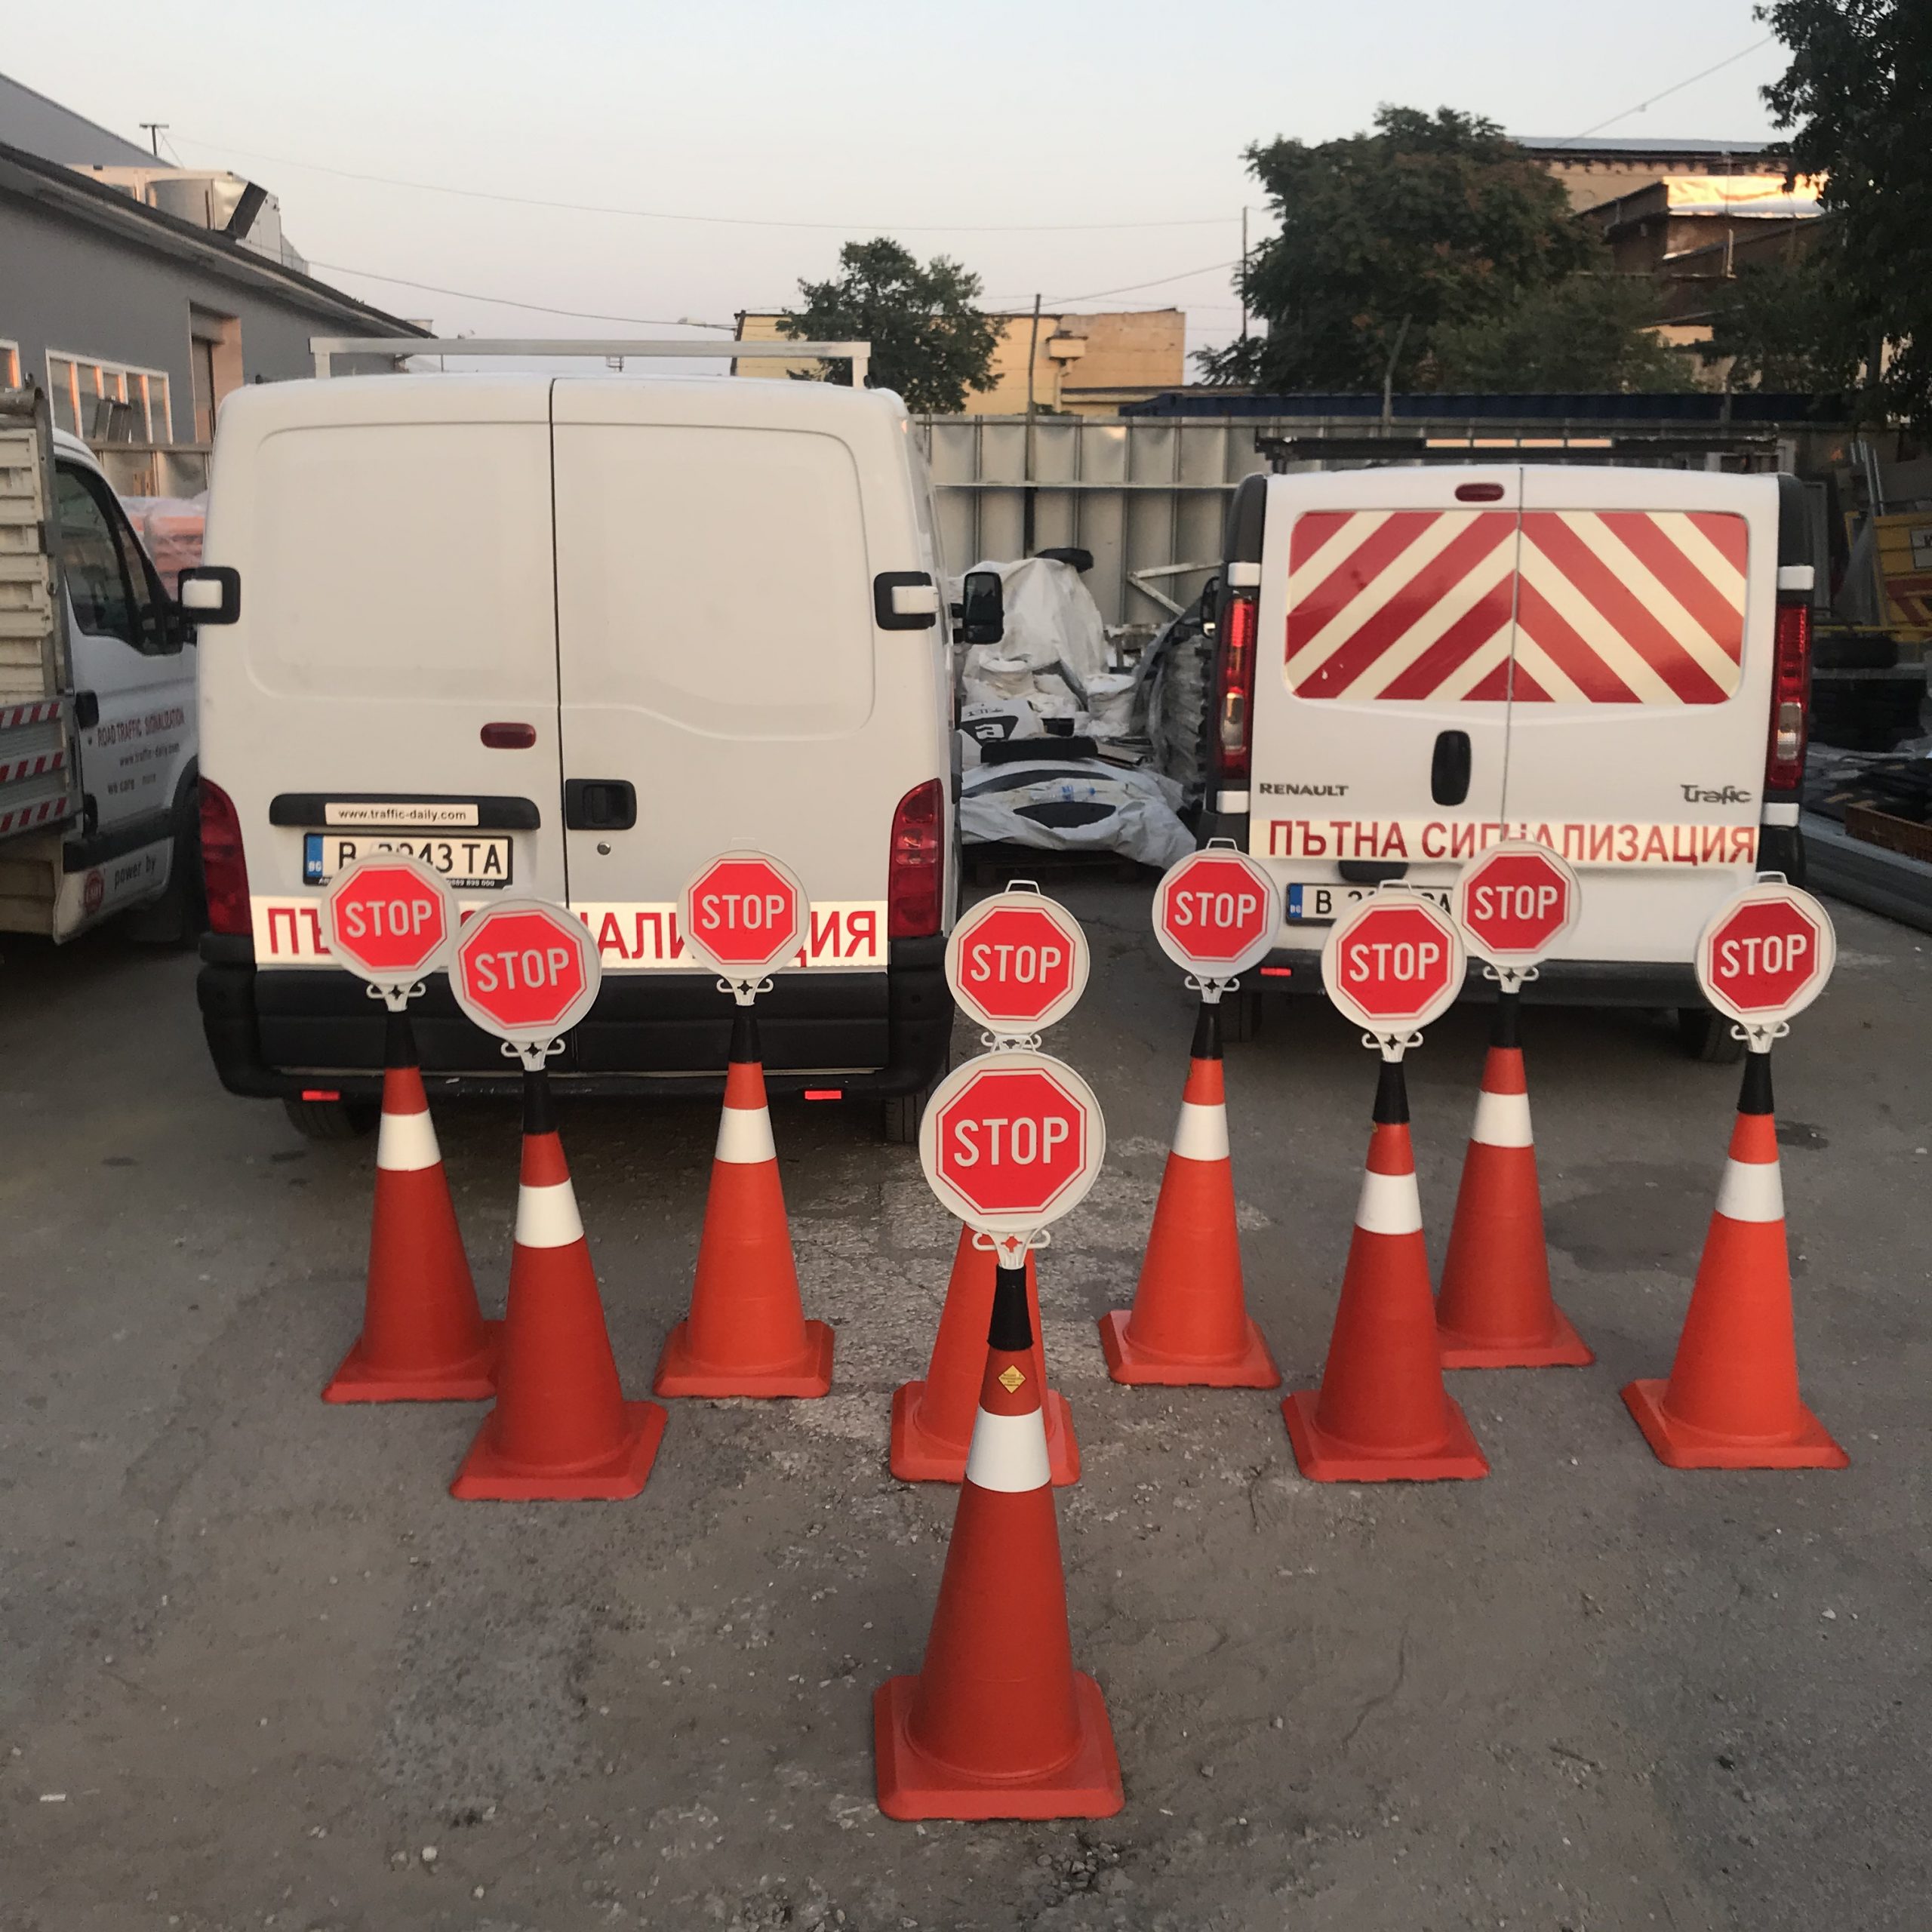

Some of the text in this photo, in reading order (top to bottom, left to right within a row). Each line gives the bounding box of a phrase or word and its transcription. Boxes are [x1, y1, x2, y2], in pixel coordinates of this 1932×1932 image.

[97, 725, 115, 747] ROAD
[1259, 783, 1349, 796] RENAULT
[1681, 784, 1752, 804] Trafic
[338, 808, 466, 823] www.traffic-daily.com
[1269, 820, 1408, 858] ПЪТНА
[115, 854, 156, 890] power by
[462, 844, 502, 875] TA
[346, 900, 432, 937] STOP
[702, 894, 784, 929] STOP
[1175, 891, 1257, 928] STOP
[1315, 890, 1332, 914] B
[1475, 885, 1558, 920] STOP
[475, 948, 569, 992] STOP
[971, 944, 1061, 983] STOP
[1350, 942, 1440, 981] STOP
[1721, 934, 1807, 977] STOP
[954, 1117, 1069, 1167] STOP
